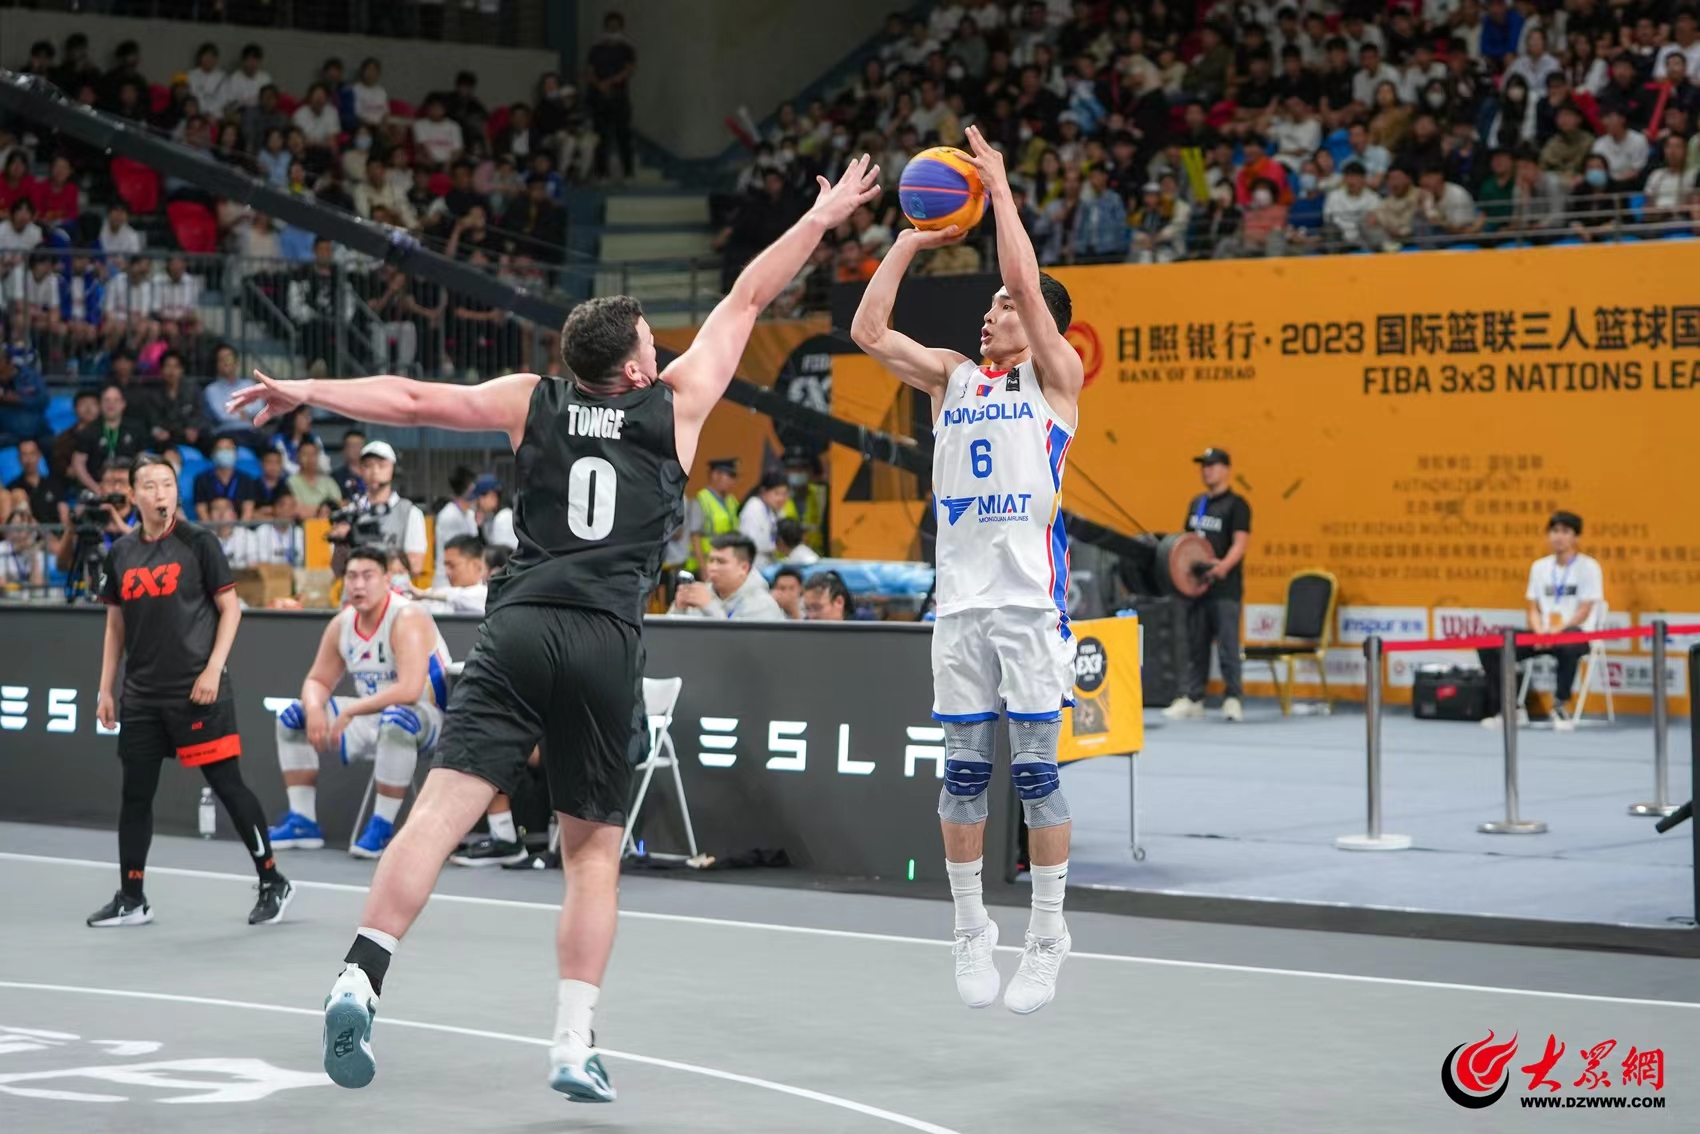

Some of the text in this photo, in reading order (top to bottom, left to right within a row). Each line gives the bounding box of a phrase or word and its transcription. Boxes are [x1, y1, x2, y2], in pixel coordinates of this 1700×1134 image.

[1281, 322, 1365, 355] 2023
[1363, 365, 1431, 394] FIBA
[1440, 364, 1496, 393] 3x3
[1506, 361, 1642, 392] NATIONS
[567, 404, 625, 439] TONGE
[970, 439, 992, 478] 6
[567, 456, 617, 541] 0
[978, 493, 1031, 515] MIAT
